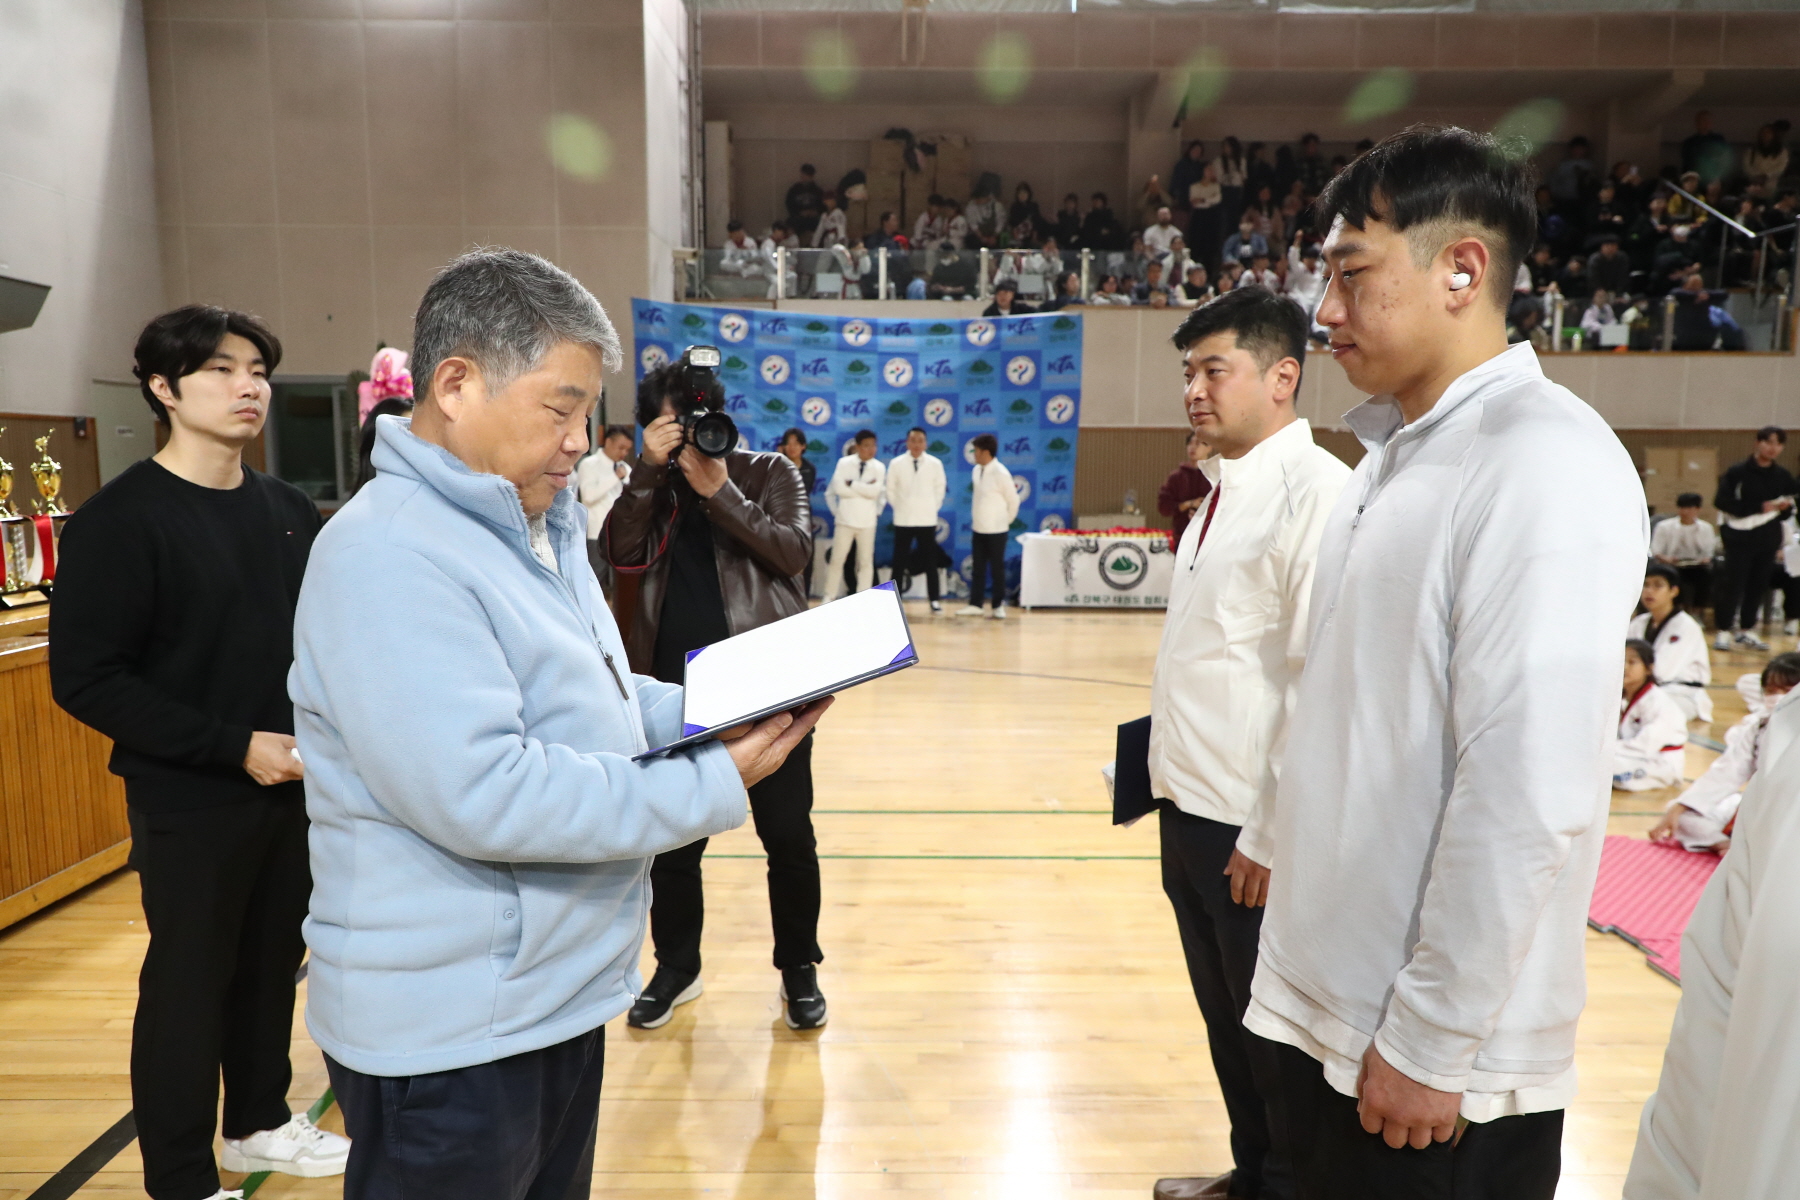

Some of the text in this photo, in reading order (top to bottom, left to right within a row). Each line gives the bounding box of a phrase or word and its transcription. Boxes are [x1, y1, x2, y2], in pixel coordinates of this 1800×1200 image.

[760, 317, 788, 334] KTA
[884, 322, 912, 336] KTA
[802, 357, 830, 375] KTA
[925, 359, 953, 377] KTA
[1047, 355, 1075, 374] KTA
[843, 399, 871, 417] KTA
[964, 398, 992, 417] KTA
[1004, 437, 1031, 454] KTA
[1043, 475, 1067, 493] KTA
